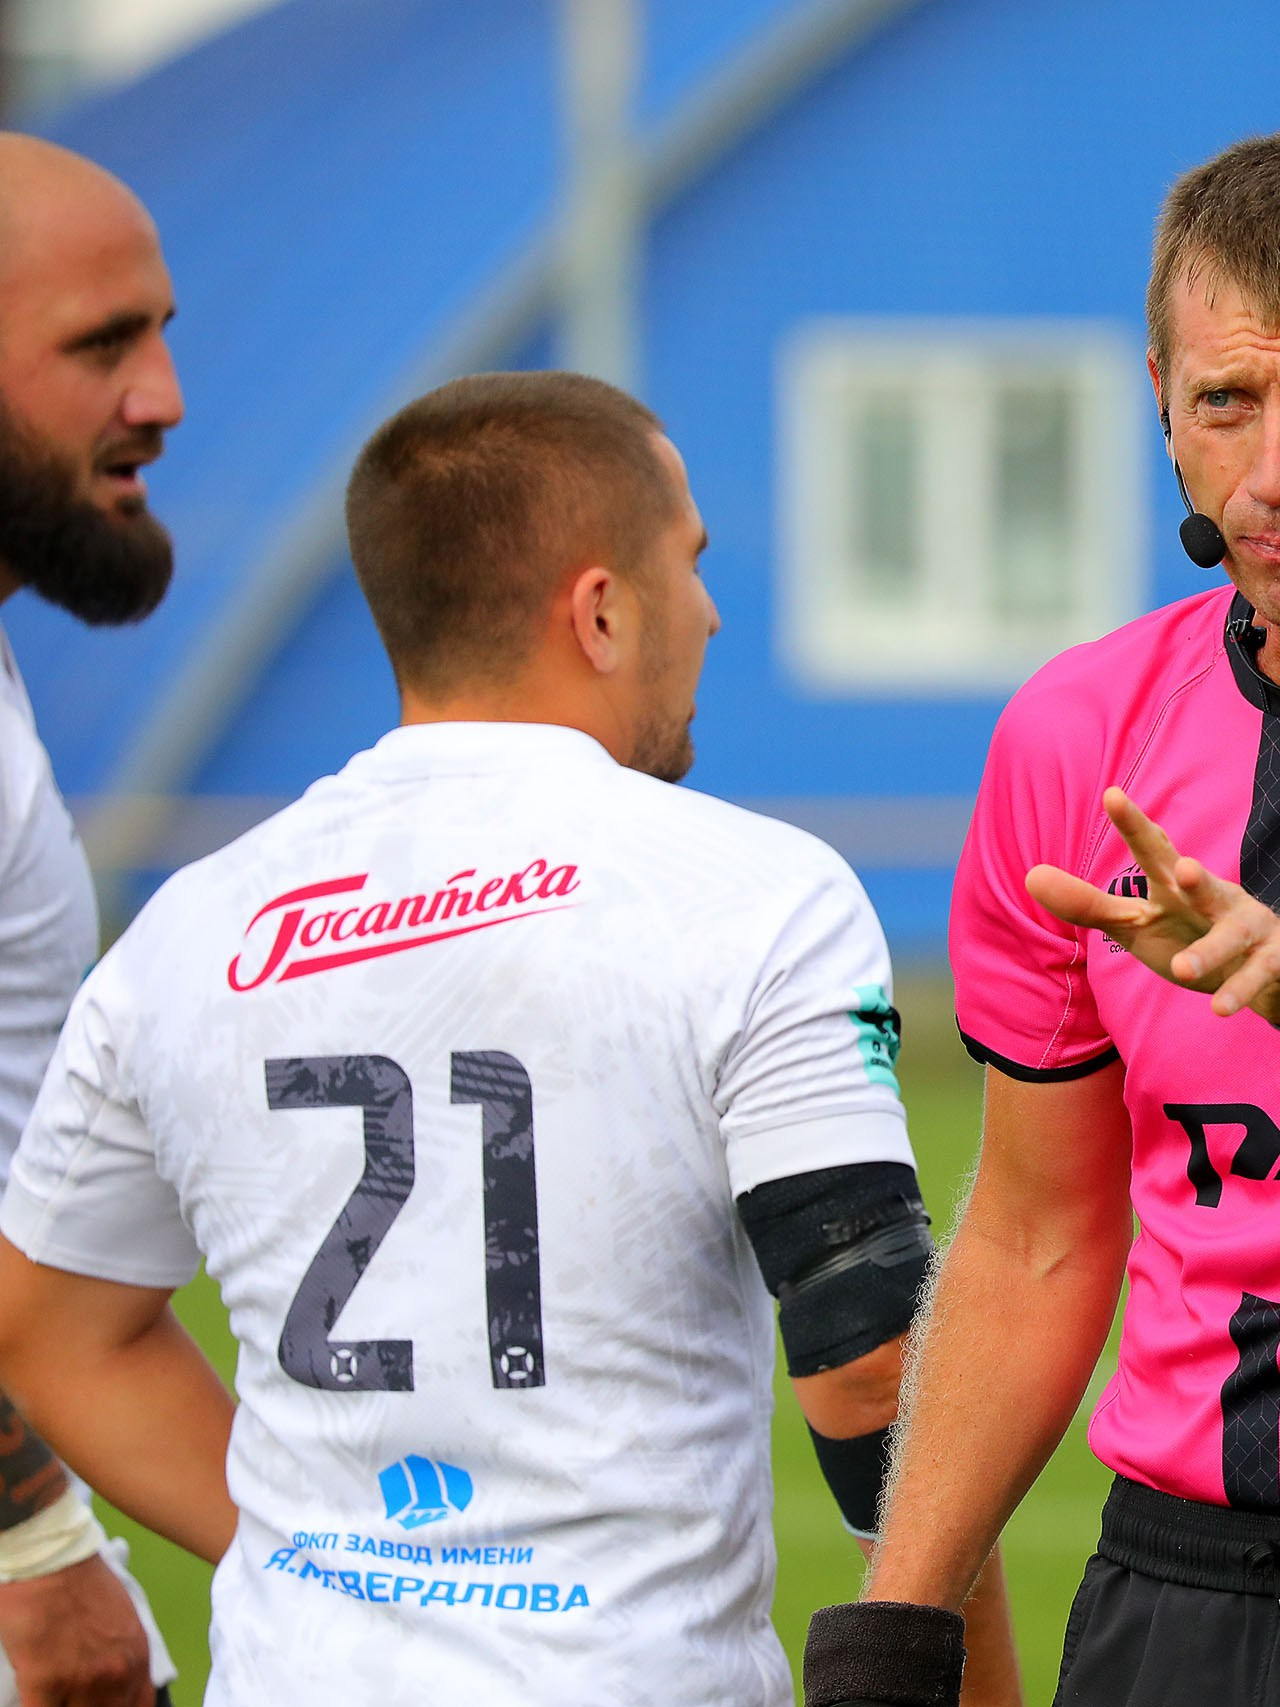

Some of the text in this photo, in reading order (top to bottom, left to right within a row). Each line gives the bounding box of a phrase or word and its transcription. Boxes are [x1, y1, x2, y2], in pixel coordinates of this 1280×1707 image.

[228, 858, 582, 992] Госаптека
[264, 1050, 546, 1392] 21
[293, 1531, 533, 1565] ФКП ЗАВОД ИМЕНИ
